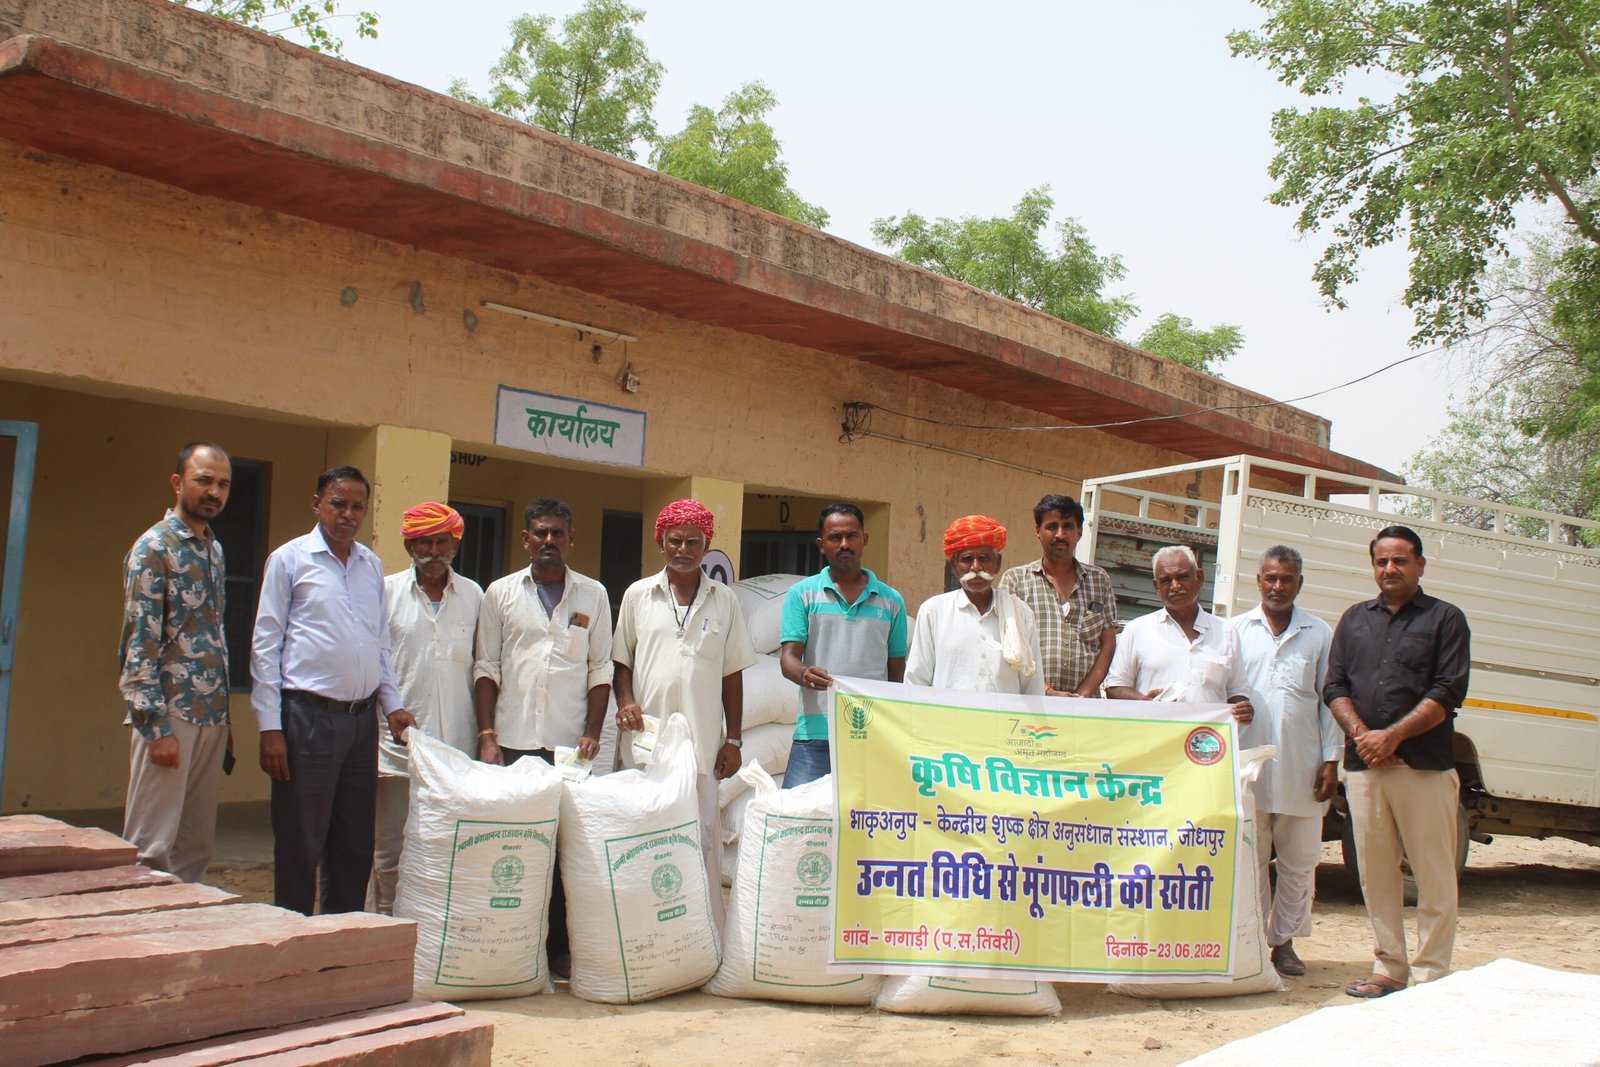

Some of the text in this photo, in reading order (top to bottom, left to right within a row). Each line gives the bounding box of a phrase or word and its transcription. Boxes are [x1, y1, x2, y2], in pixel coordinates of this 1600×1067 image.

[525, 405, 621, 449] कार्यालय
[780, 501, 790, 524] D
[910, 752, 1164, 806] कृषि विज्ञान केन्द्र
[850, 808, 918, 840] भाकृअनुप
[936, 804, 987, 835] केन्द्रीय
[991, 814, 1024, 844] शुष्क
[1027, 811, 1050, 840] क्षेत्र
[1052, 817, 1113, 851] अनुसंधान
[1116, 820, 1174, 850] संस्थान,
[1177, 820, 1226, 857] जोधपुर
[857, 859, 928, 898] उन्नत
[931, 850, 994, 900] विधि
[997, 853, 1020, 902] से
[1021, 855, 1115, 919] मूंगफली
[1117, 863, 1156, 910] की
[1158, 863, 1214, 911] खेती
[884, 925, 929, 951] गगाड़ी
